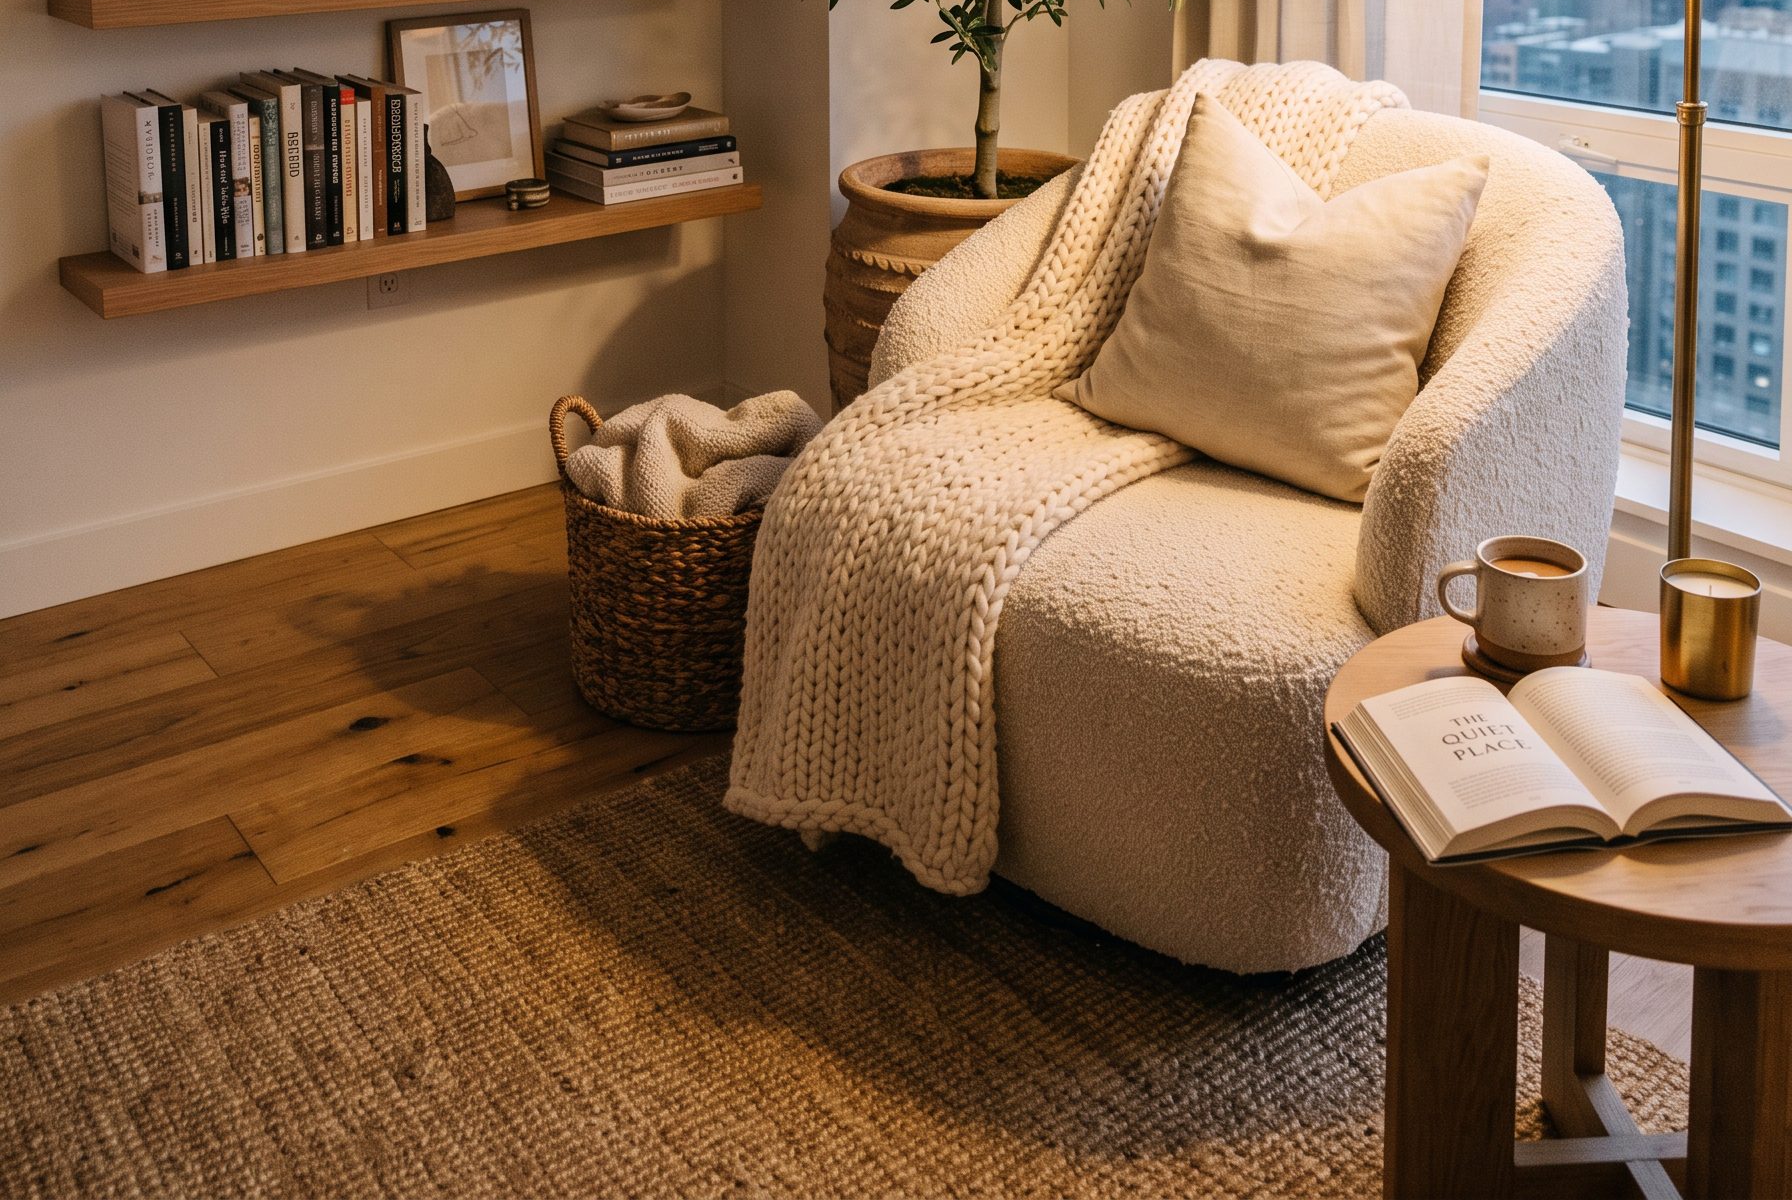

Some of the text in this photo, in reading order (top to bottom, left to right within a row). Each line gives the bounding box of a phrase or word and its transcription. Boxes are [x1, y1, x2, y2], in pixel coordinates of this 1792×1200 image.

[1449, 714, 1488, 726] THE
[1442, 724, 1515, 745] QUIET
[1453, 739, 1532, 760] PLACE
